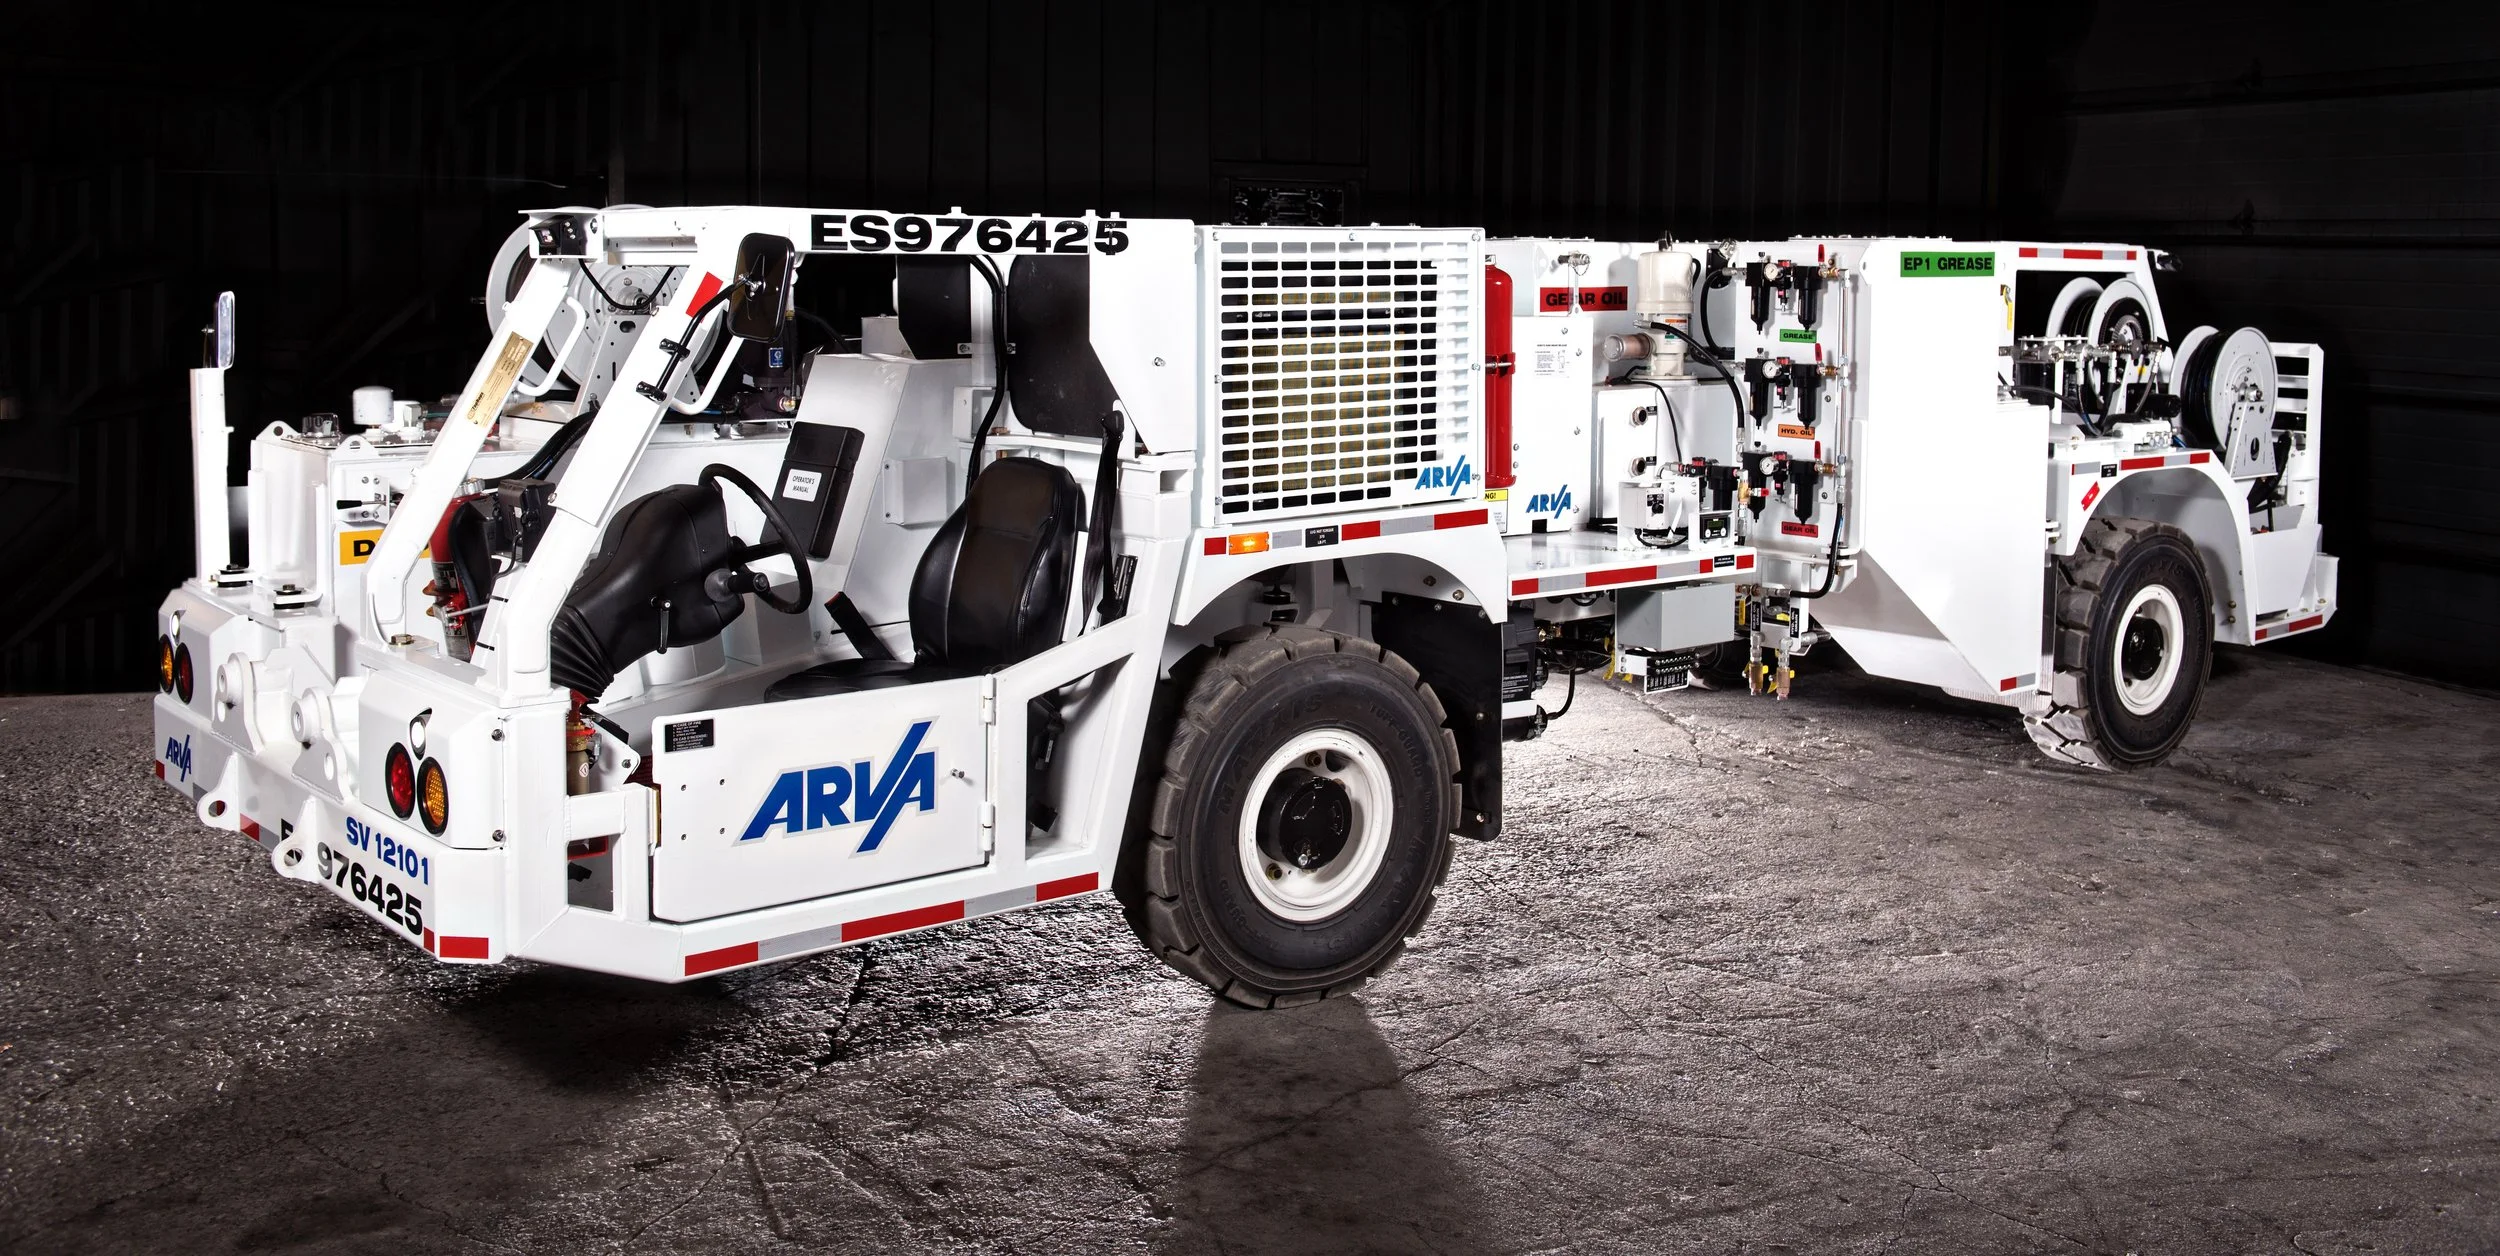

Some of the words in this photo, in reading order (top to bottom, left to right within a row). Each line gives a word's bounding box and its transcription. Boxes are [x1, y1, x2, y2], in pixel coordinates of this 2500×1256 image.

[811, 214, 1129, 255] ES976425
[1904, 257, 1931, 271] EP1
[1937, 257, 1993, 271] GREASE
[1601, 291, 1627, 305] OIL
[1783, 332, 1814, 340] GREASE
[792, 475, 815, 485] OPERATOR'S
[1415, 455, 1471, 496] ARVA
[793, 485, 809, 493] MANUAL
[1526, 484, 1572, 519] ARVA
[1783, 525, 1803, 533] GEAR
[165, 734, 192, 782] ARVA
[740, 721, 935, 853] ARVA
[346, 817, 370, 851] SV
[376, 833, 429, 885] 12101
